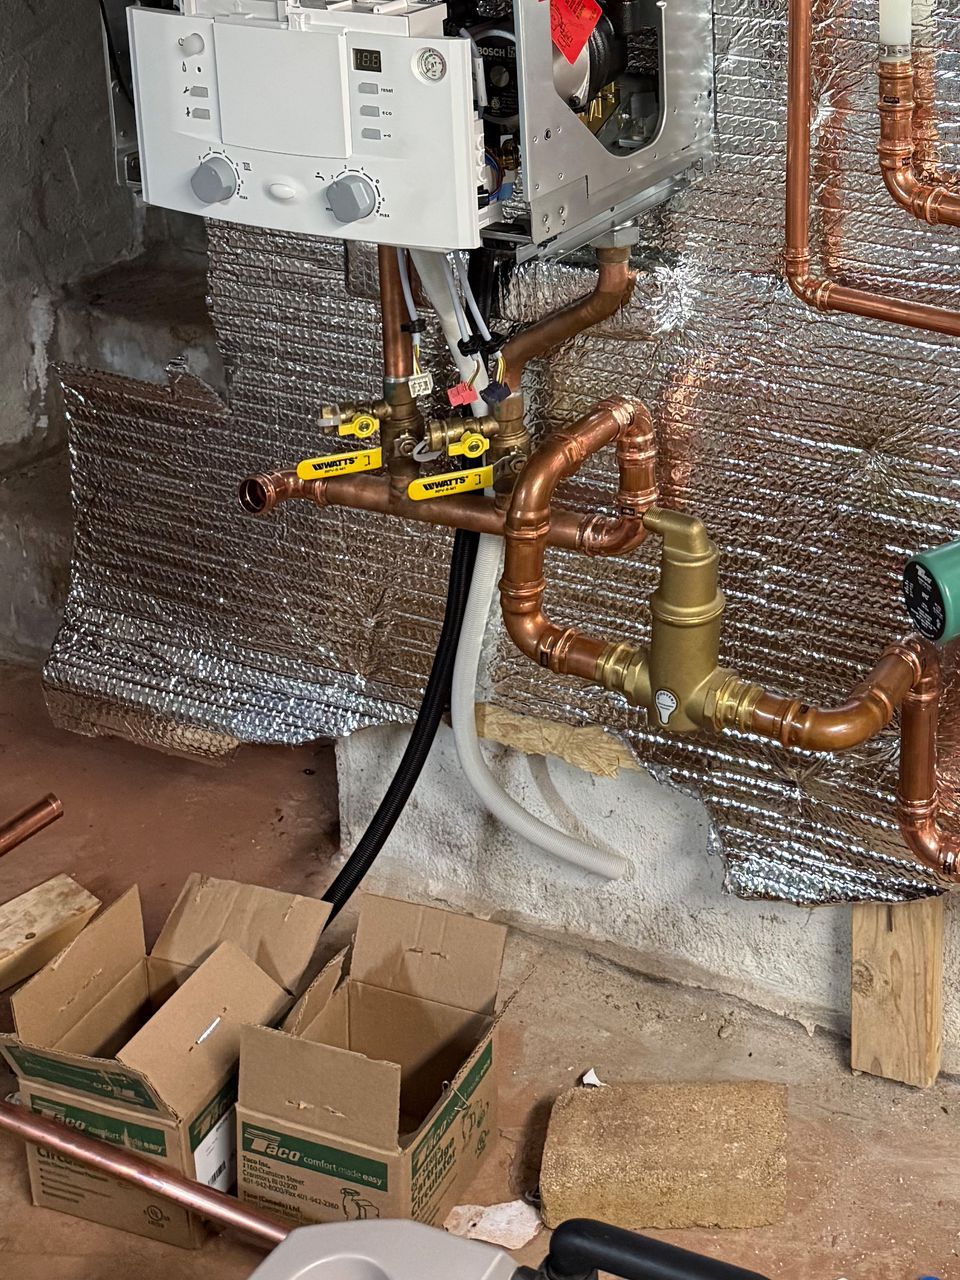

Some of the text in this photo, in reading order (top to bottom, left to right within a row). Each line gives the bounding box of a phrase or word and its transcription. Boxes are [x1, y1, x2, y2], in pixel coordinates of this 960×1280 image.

[479, 47, 505, 57] BOSCH
[317, 456, 357, 470] WATTS
[428, 475, 468, 489] WATTS
[244, 1128, 383, 1186] Taco comfort made easy
